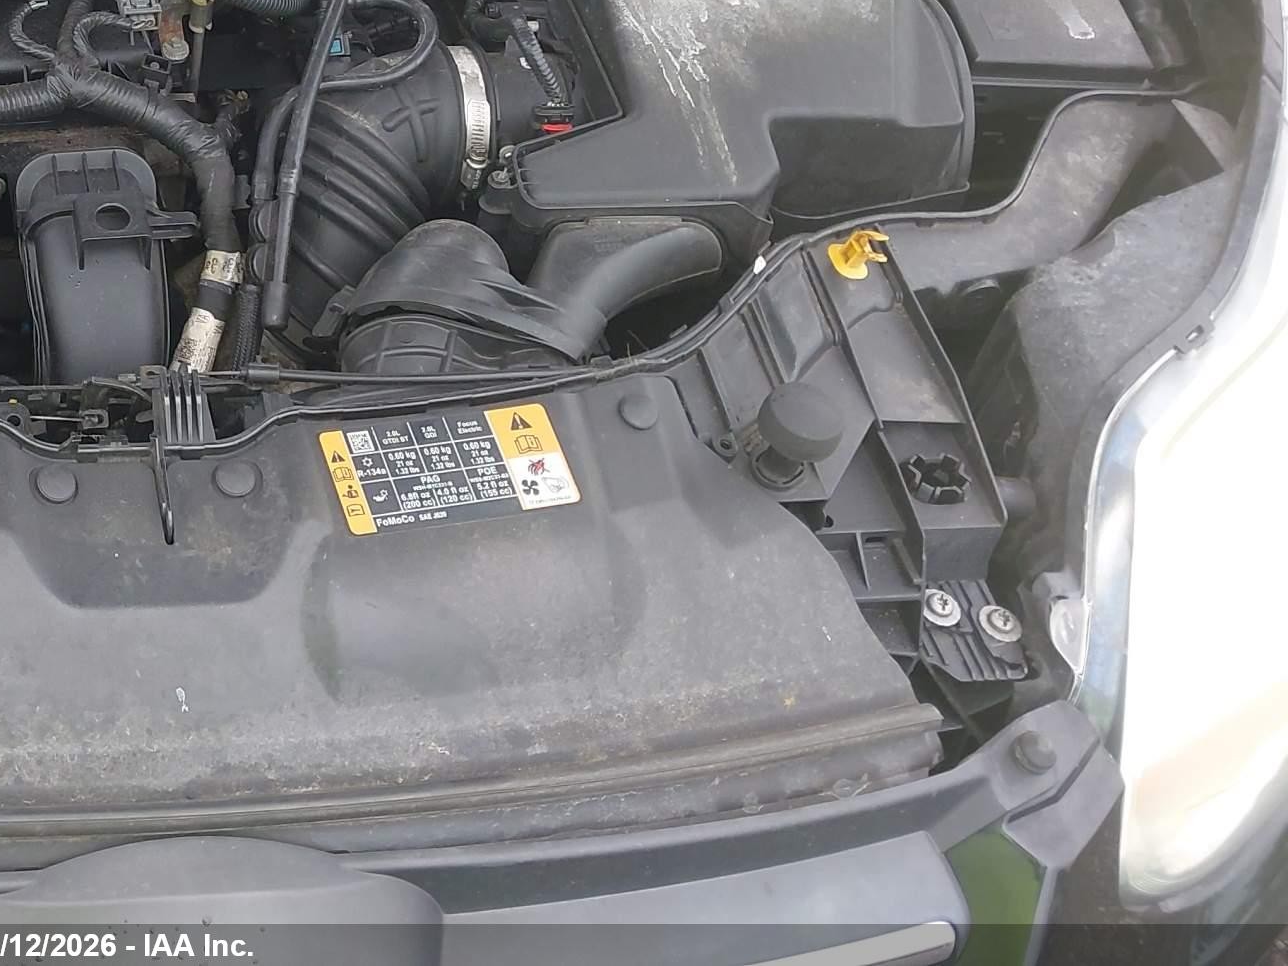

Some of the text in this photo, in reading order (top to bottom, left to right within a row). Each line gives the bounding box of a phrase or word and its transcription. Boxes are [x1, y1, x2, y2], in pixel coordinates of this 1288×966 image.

[457, 426, 482, 434] Electric
[463, 441, 491, 451] 0.60 kg
[423, 446, 451, 456] 0.60 kg
[388, 451, 416, 461] 0.60 kg
[471, 457, 484, 465] 1.32
[357, 468, 387, 477] R-134a
[396, 467, 409, 475] 1.32
[477, 466, 498, 475] POE
[420, 475, 440, 484] PAG
[477, 482, 490, 490] 5.2
[421, 491, 431, 499] oz
[437, 487, 449, 496] 4.0
[480, 487, 513, 498] (155 cc)
[403, 498, 436, 509] (200 cc)
[440, 493, 473, 505] (120 cc)
[376, 515, 415, 527] FoMoCo
